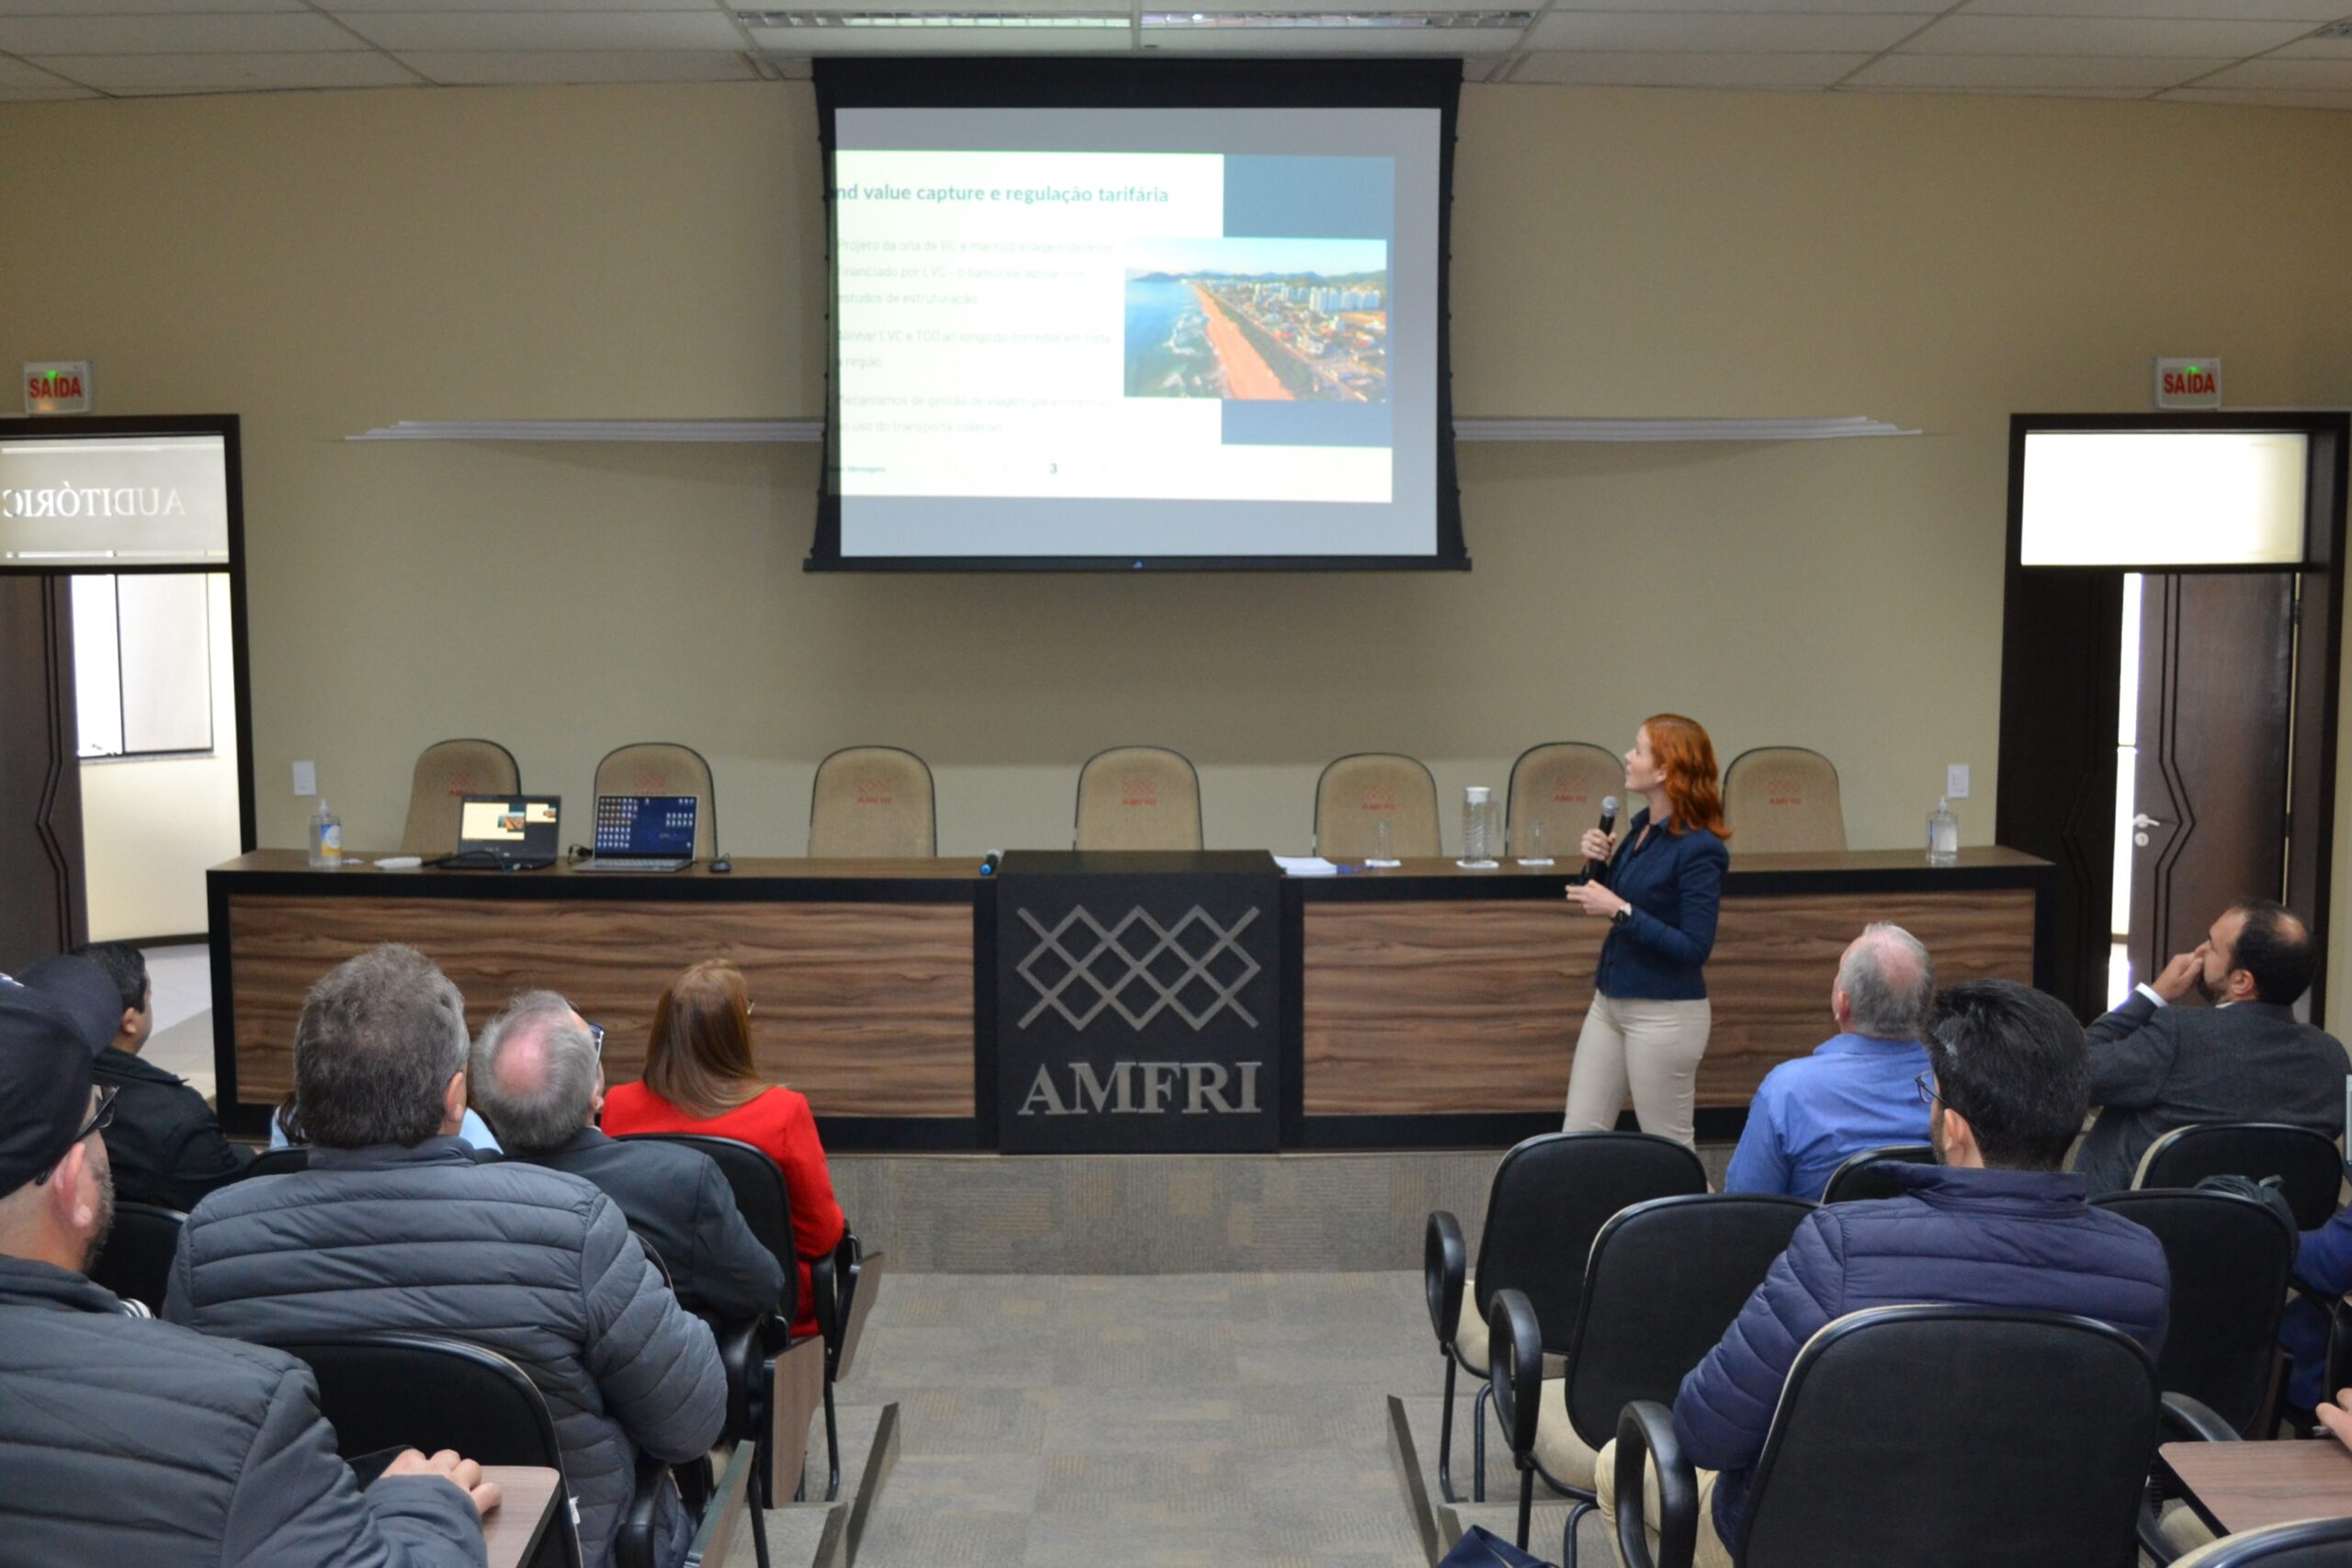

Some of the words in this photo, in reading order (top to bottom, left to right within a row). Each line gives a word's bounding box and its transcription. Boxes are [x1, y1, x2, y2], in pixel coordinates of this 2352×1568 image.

[833, 184, 858, 199] nd
[864, 184, 911, 200] value
[917, 186, 985, 204] capture
[990, 188, 1001, 201] e
[1006, 186, 1092, 205] regulação
[1099, 186, 1169, 203] tarifária
[882, 241, 897, 253] da
[923, 241, 937, 253] de
[900, 267, 919, 281] por
[922, 266, 945, 278] LVC
[886, 293, 899, 304] de
[902, 293, 978, 307] estruturação
[880, 330, 903, 343] LVC
[29, 373, 82, 399] SAÍDA
[2163, 369, 2216, 394] SAÍDA
[910, 395, 924, 406] de
[1049, 463, 1057, 475] 3
[1017, 1062, 1262, 1115] AMFRI
